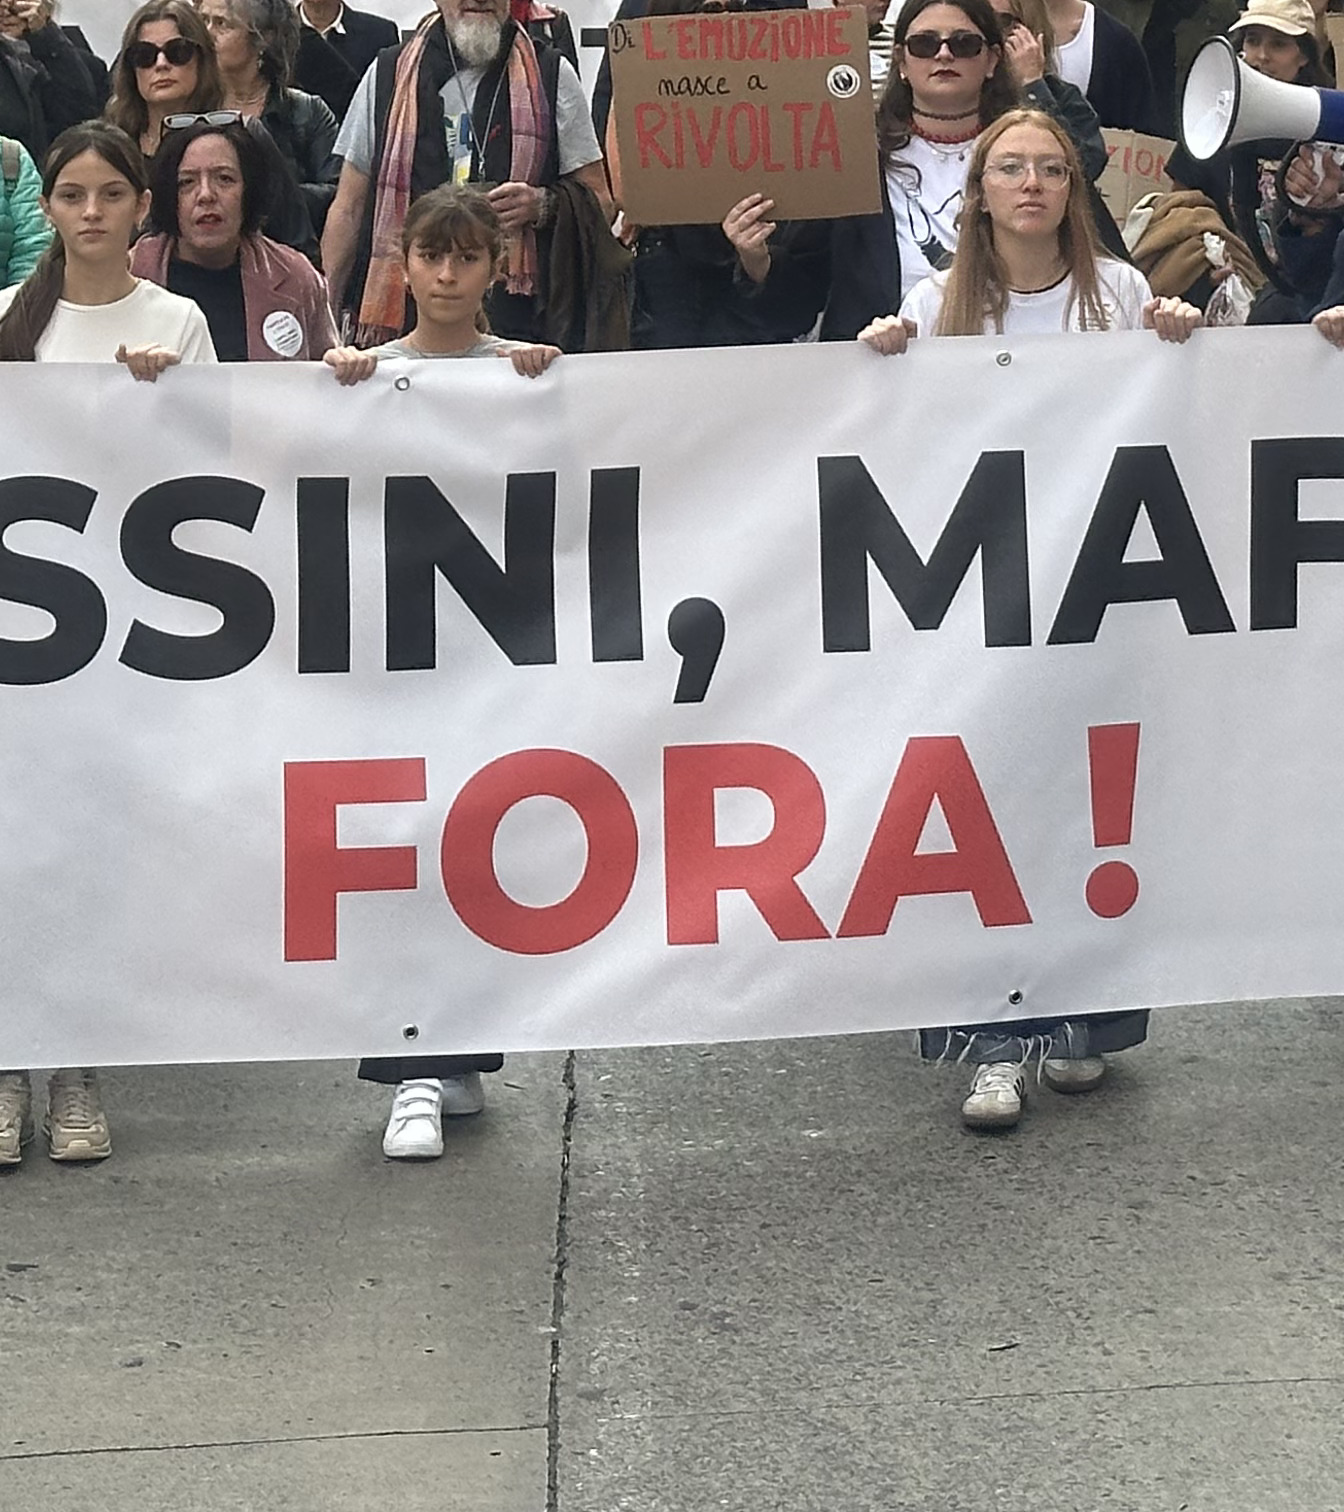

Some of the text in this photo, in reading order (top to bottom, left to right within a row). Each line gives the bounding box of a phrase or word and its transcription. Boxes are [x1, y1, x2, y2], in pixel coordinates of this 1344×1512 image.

[657, 73, 768, 97] nasce a
[286, 737, 1029, 961] FORA
